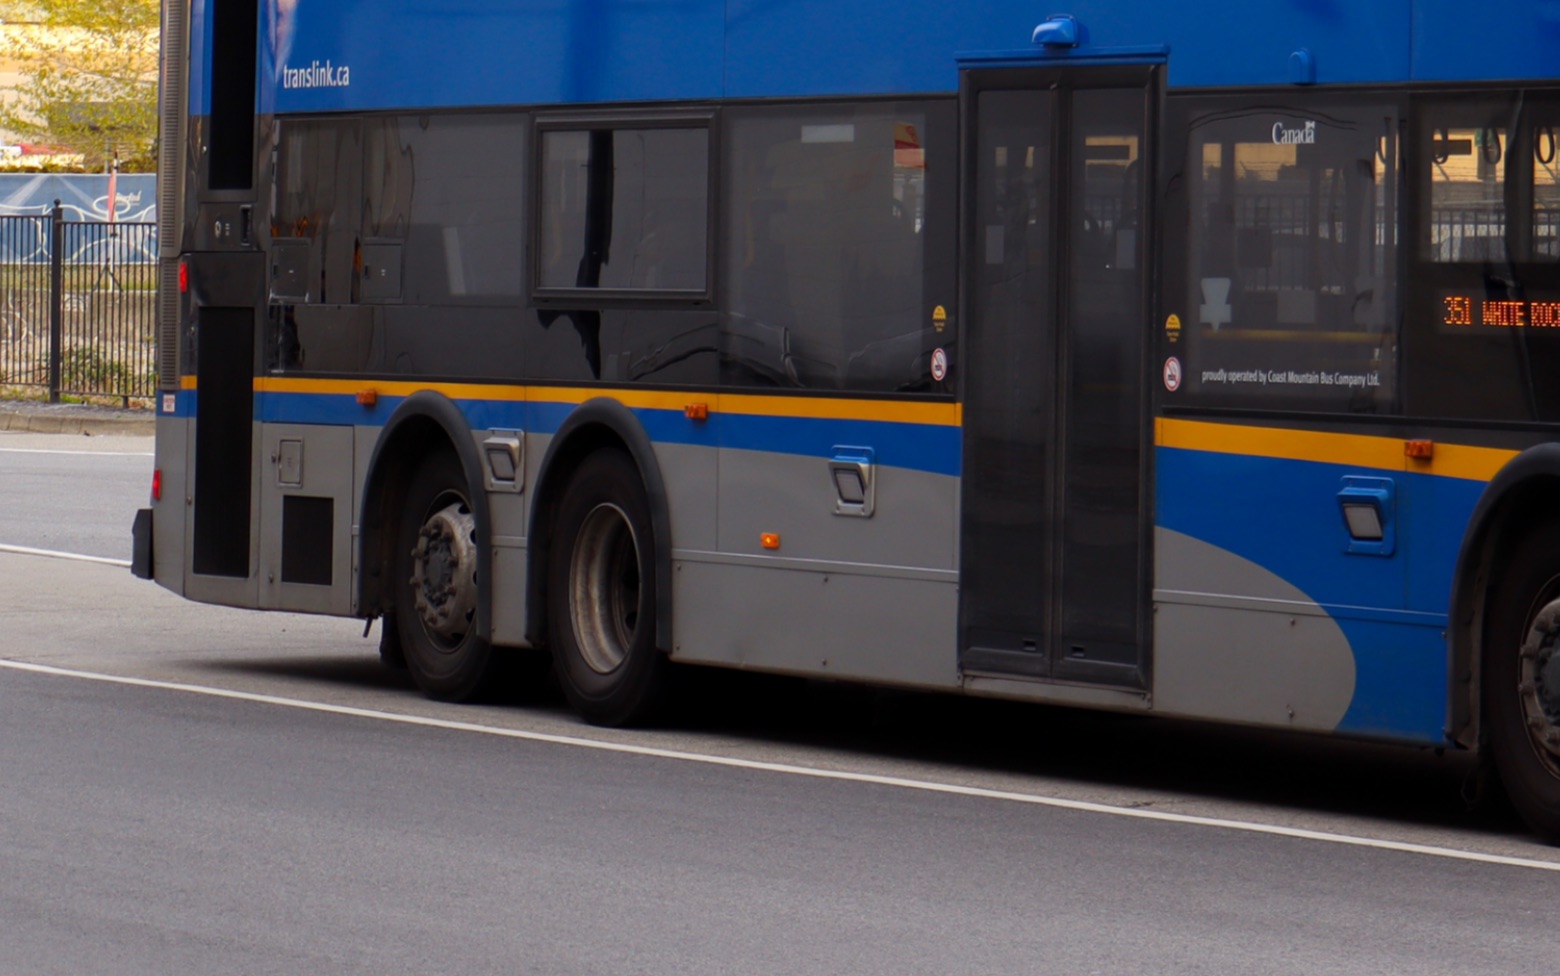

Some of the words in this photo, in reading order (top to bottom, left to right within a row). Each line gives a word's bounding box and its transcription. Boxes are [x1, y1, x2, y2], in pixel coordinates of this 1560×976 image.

[283, 59, 350, 89] translink.ca
[1272, 120, 1316, 145] Canada
[1443, 296, 1472, 325] 351
[1482, 301, 1524, 326] WHITE
[1202, 369, 1227, 384] proudly
[1228, 370, 1257, 384] operated
[1258, 370, 1266, 385] by
[1267, 370, 1286, 384] Coast
[1287, 371, 1319, 385] Mountain
[1320, 372, 1333, 385] Bus
[1334, 372, 1365, 388] Company
[1367, 372, 1380, 386] Ltd.
